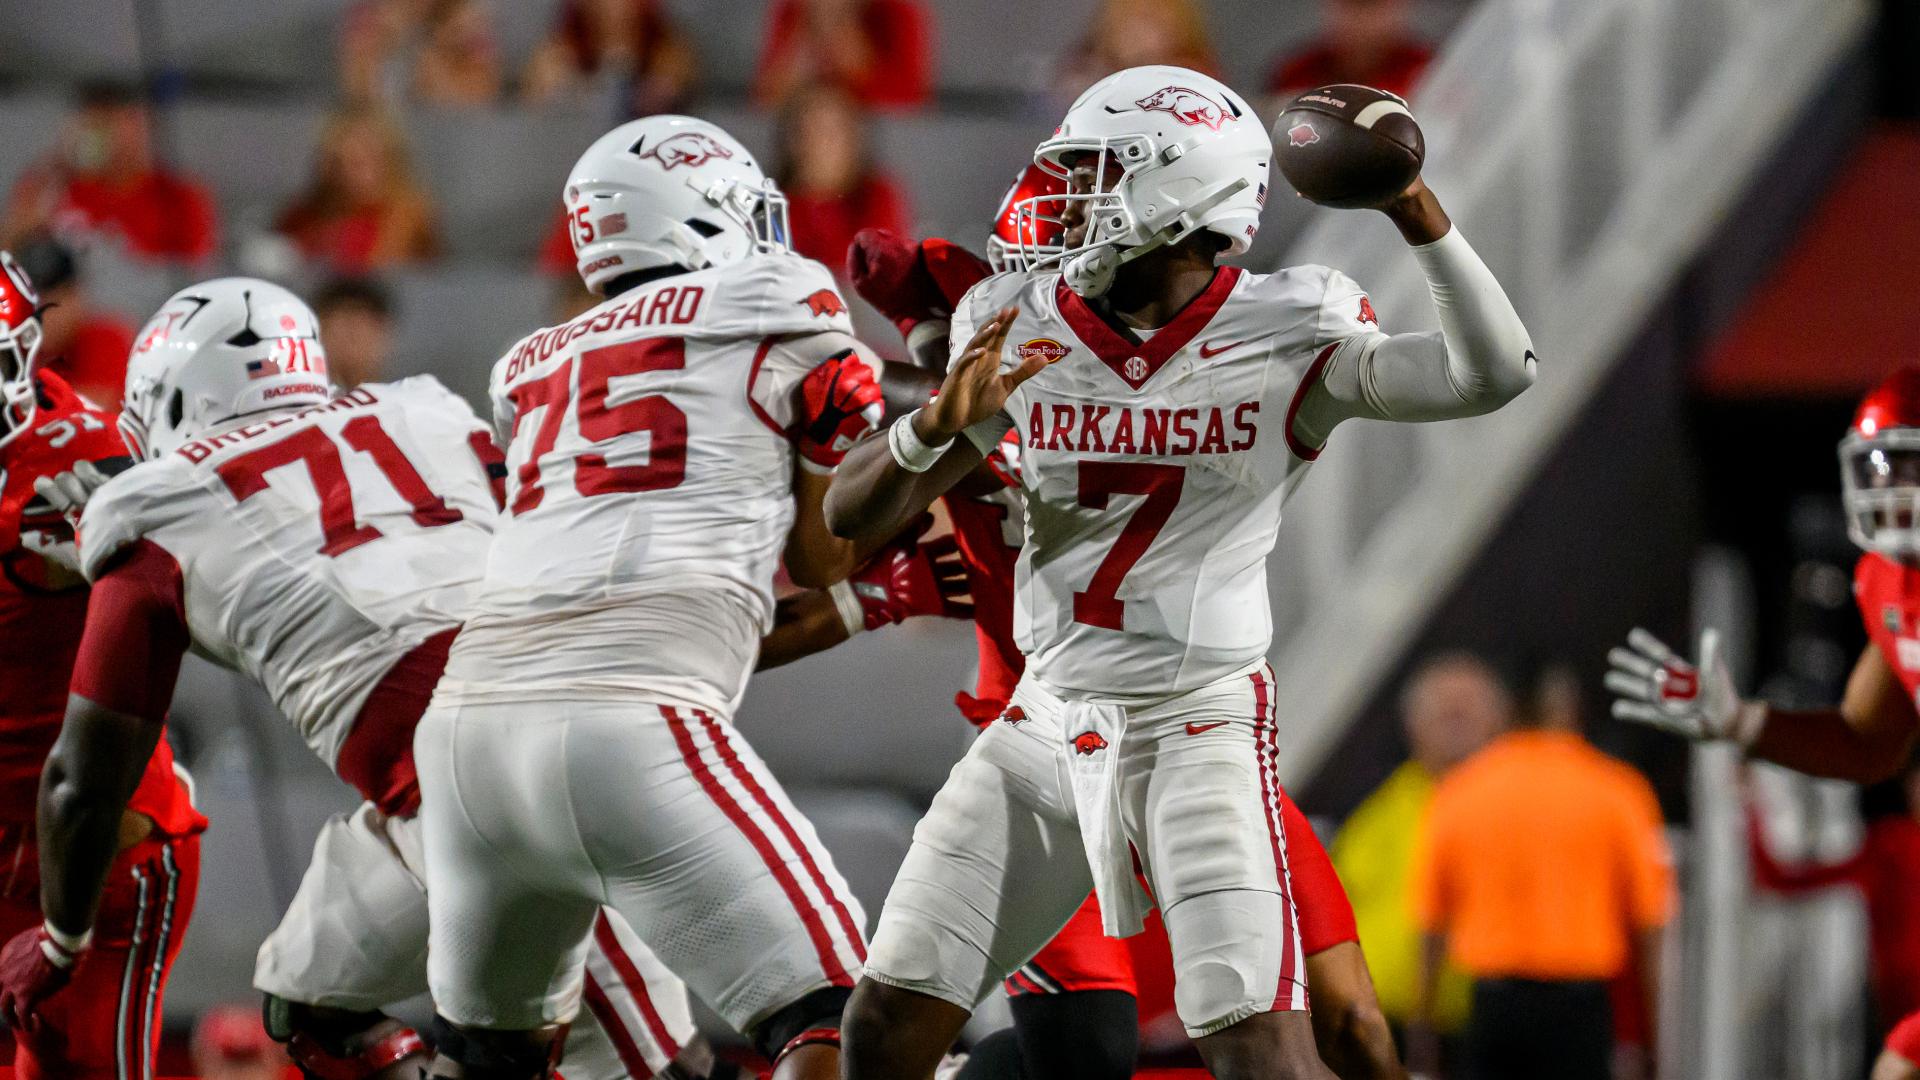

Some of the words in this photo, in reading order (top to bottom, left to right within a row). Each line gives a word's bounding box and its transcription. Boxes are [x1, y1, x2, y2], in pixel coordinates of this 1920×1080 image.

[505, 286, 704, 385] BROUSSARD
[1041, 345, 1066, 355] Foods
[1123, 356, 1149, 380] SEC
[506, 336, 688, 517] 75
[1028, 401, 1260, 455] ARKANSAS
[214, 413, 463, 557] 71
[1073, 460, 1186, 631] 7
